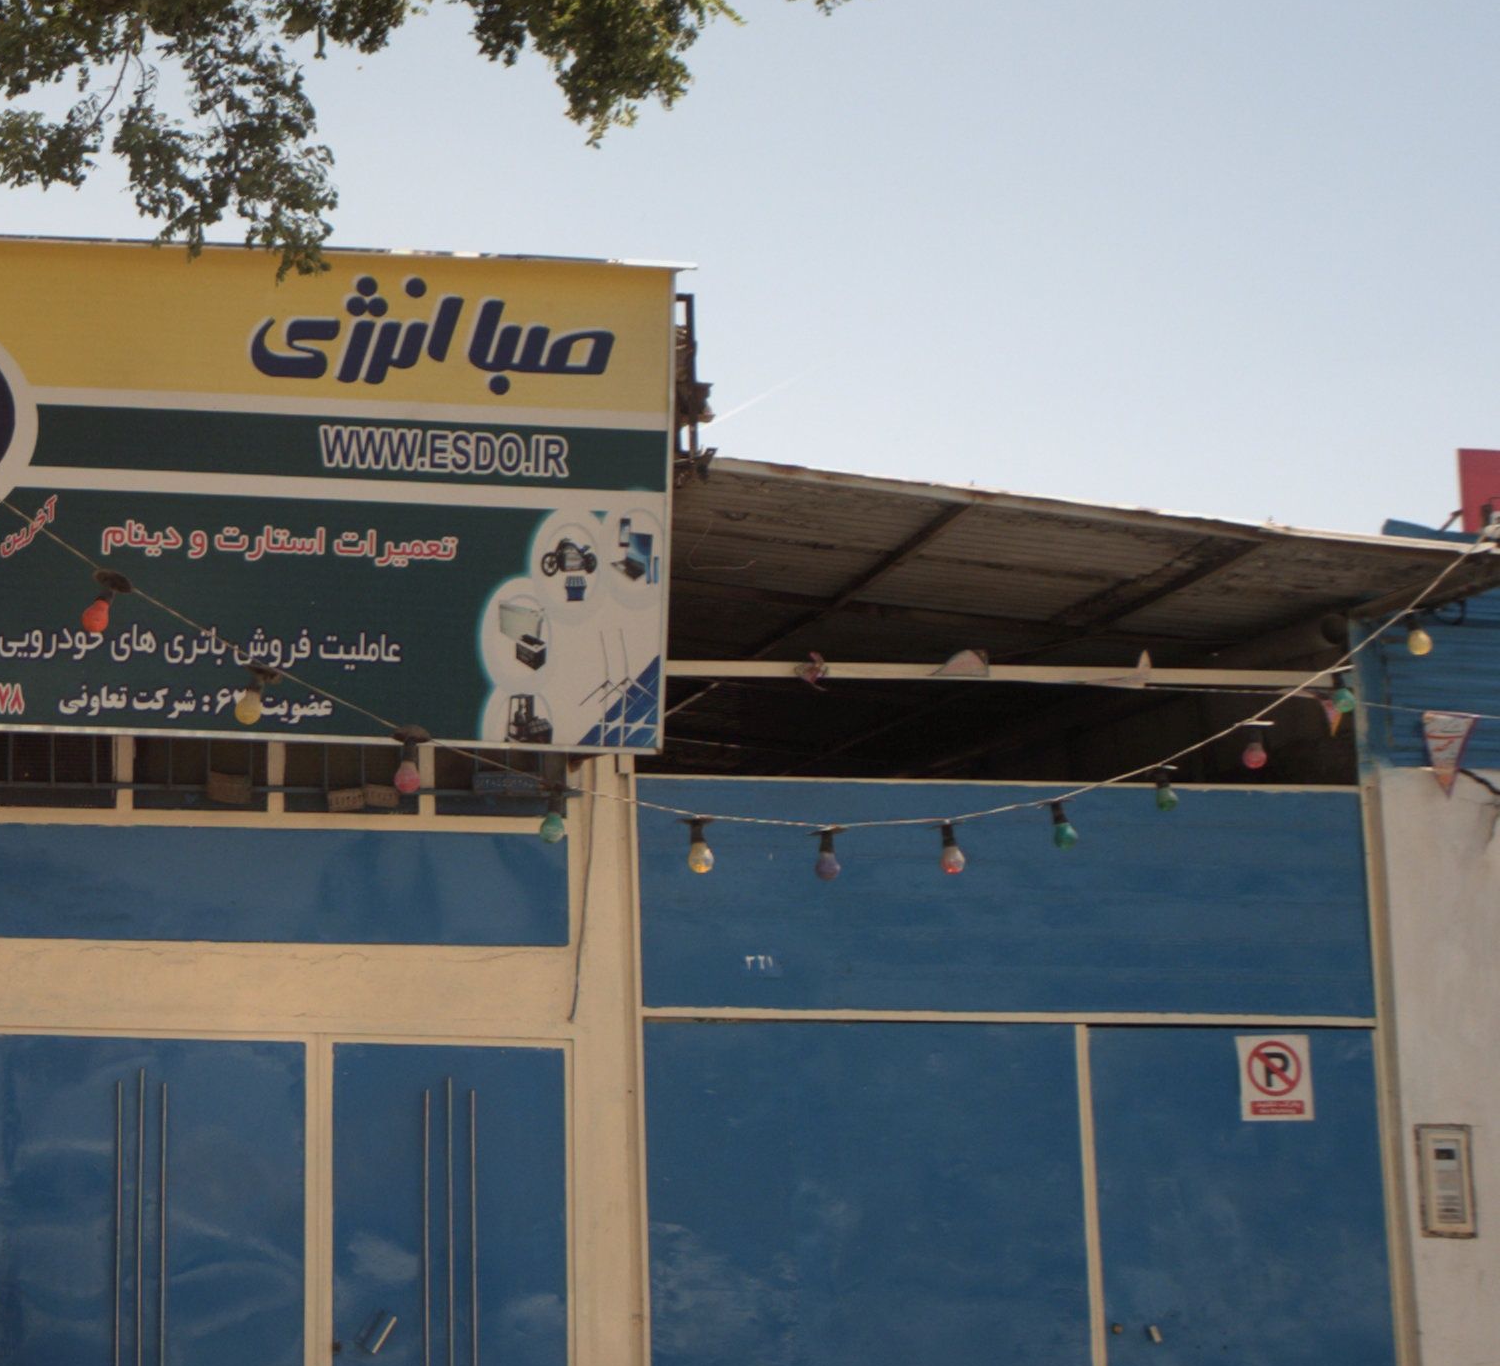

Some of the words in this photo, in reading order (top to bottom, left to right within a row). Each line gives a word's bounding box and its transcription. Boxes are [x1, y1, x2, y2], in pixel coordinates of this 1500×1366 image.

[251, 275, 464, 385] انرژی
[468, 298, 615, 396] صبا
[319, 424, 569, 478] WWW.ESDO.IR
[0, 494, 58, 560] آخرین
[101, 519, 183, 557] دینام
[188, 530, 208, 560] و
[215, 524, 326, 562] استارت
[334, 528, 458, 568] تعمیرات
[110, 624, 156, 663] های
[164, 626, 227, 665] باتری
[233, 628, 311, 669] فروش
[317, 632, 401, 671] عاملیت
[59, 683, 128, 716] تعاونی
[132, 685, 196, 719] شرکت
[260, 694, 333, 724] عضویت
